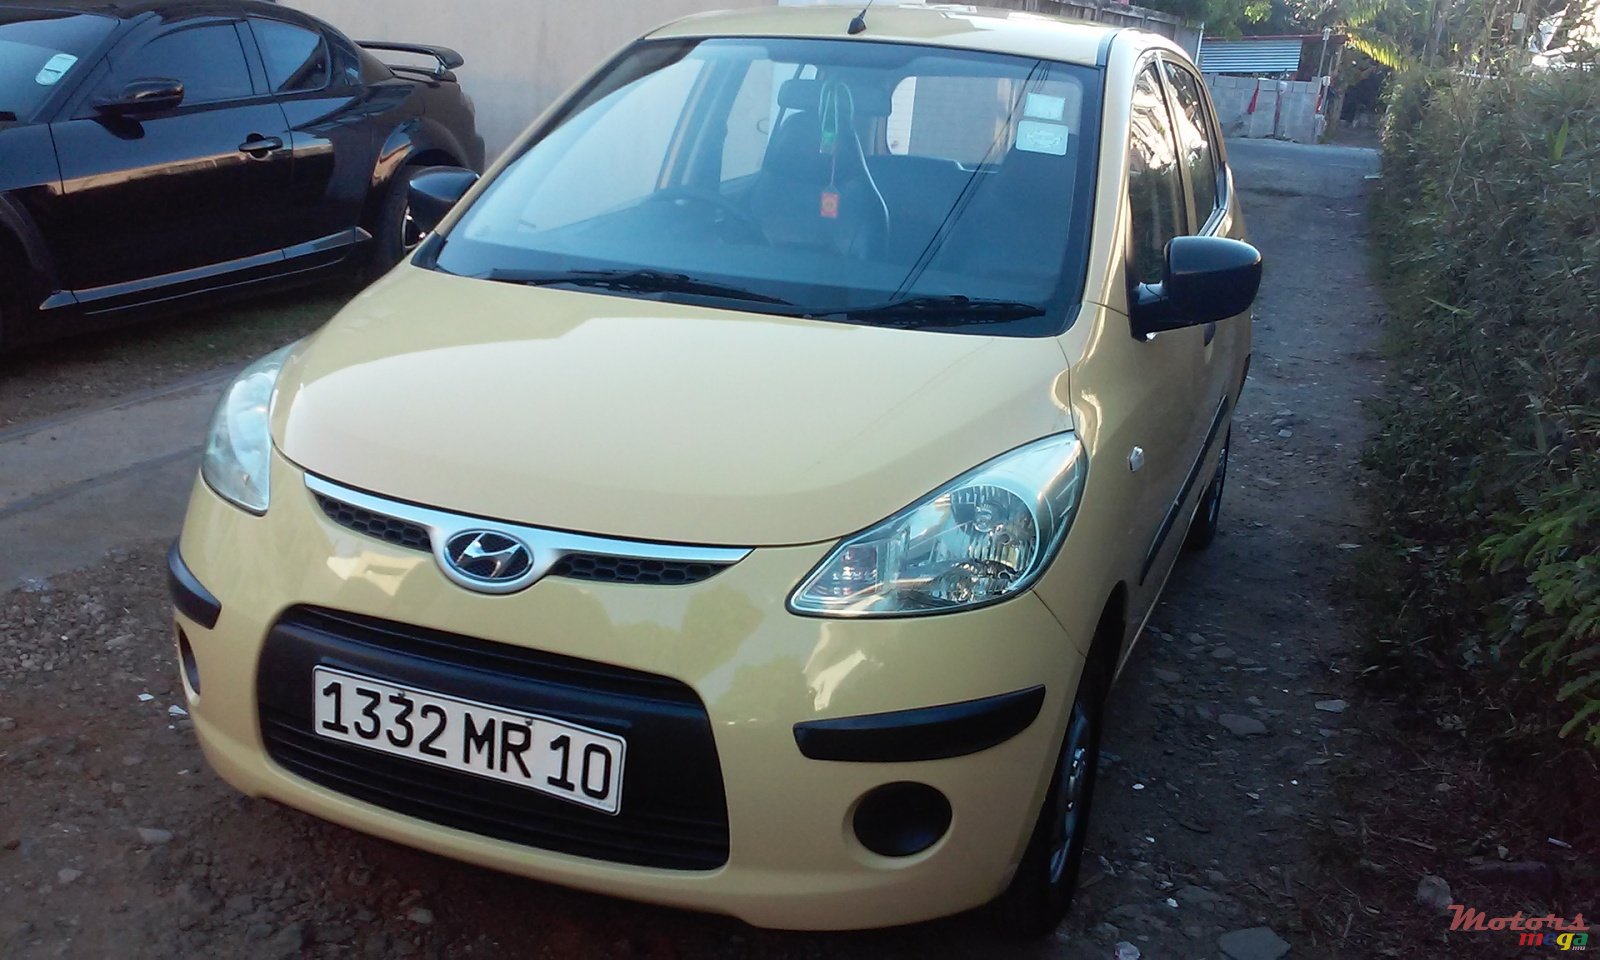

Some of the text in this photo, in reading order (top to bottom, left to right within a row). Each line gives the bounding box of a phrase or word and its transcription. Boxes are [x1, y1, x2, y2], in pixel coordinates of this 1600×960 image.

[322, 681, 612, 800] 1332 MR 10
